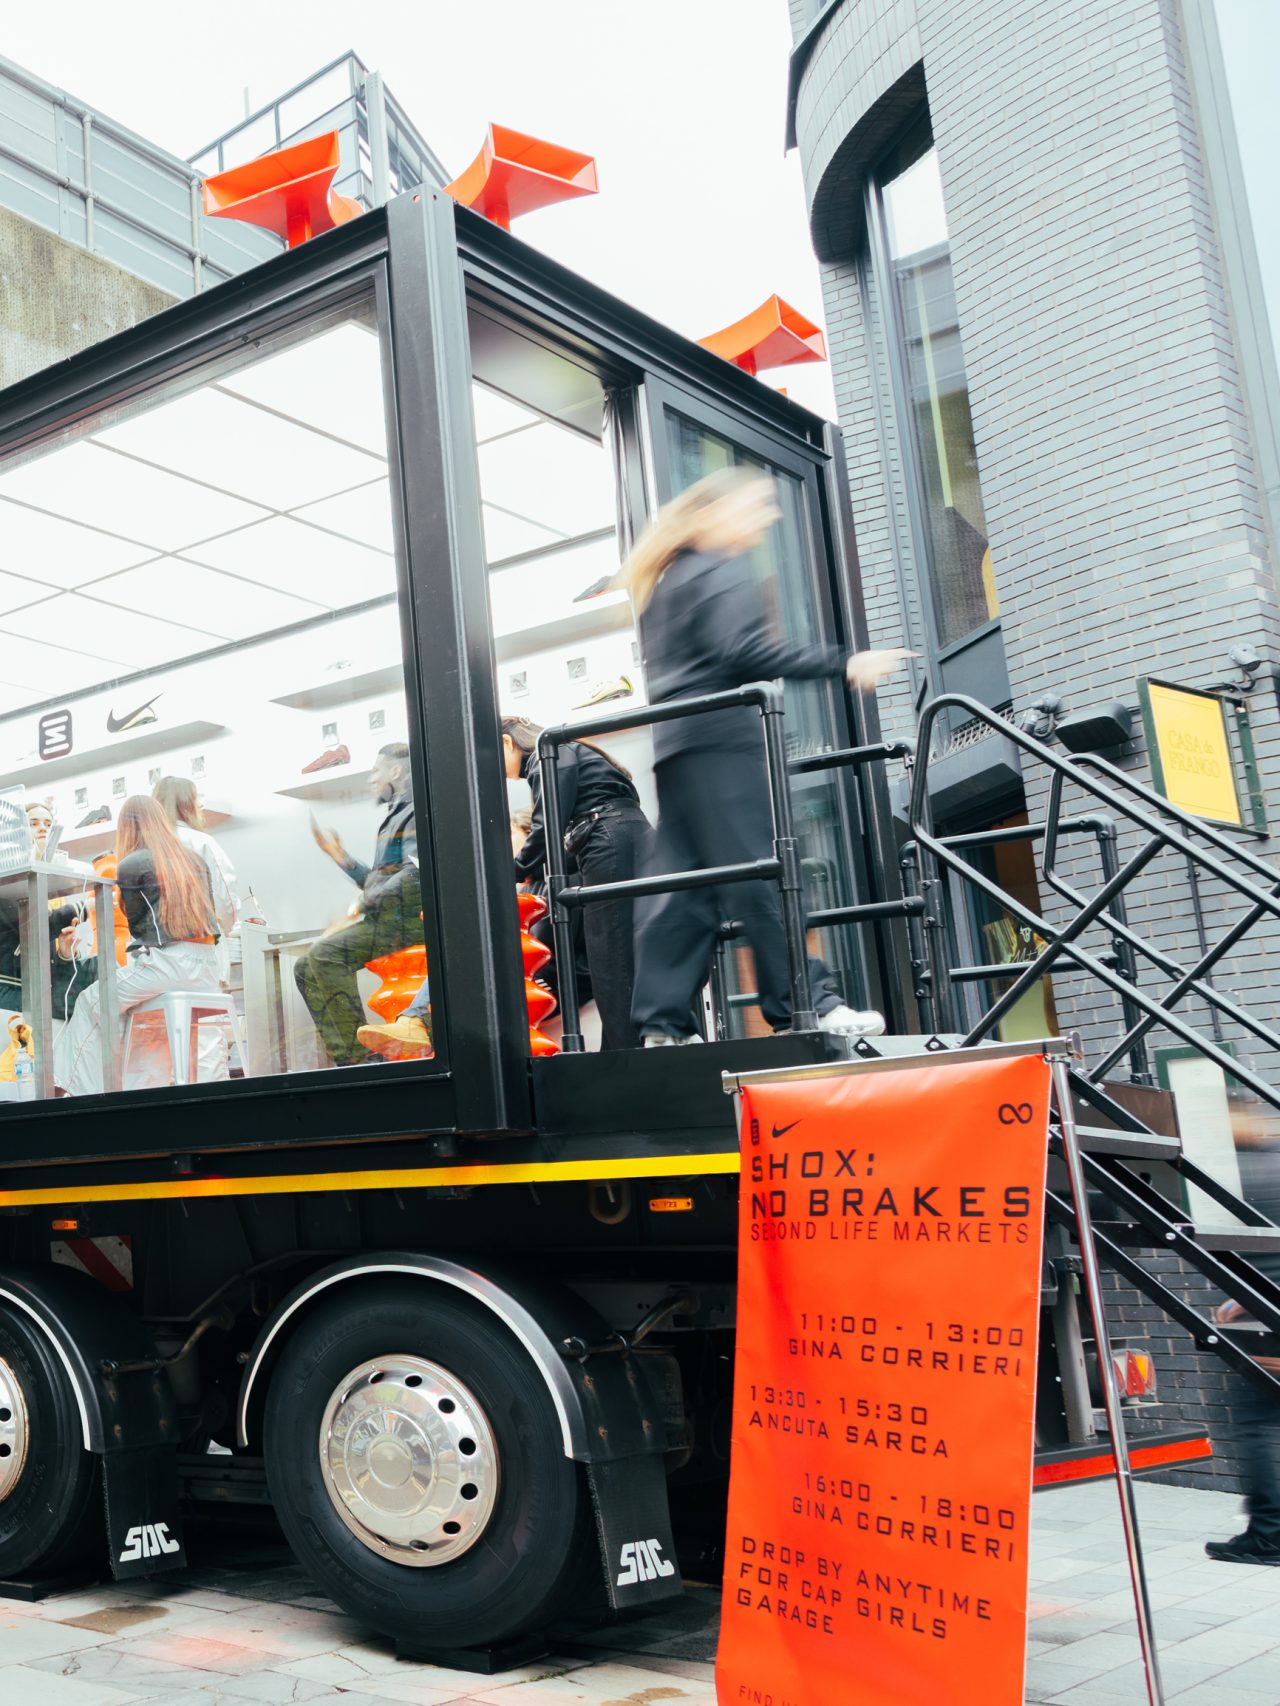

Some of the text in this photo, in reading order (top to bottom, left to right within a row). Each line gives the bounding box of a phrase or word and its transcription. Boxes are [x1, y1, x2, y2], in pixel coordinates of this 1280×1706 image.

[1168, 750, 1220, 778] FRANGO
[752, 1149, 876, 1182] SHOX:
[752, 1186, 1030, 1219] NO BRAKES
[751, 1221, 1028, 1244] SECOND LIFE MARKETS
[800, 1313, 876, 1335] 11:00
[926, 1322, 1024, 1346] 13:00
[789, 1338, 1022, 1377] GINA CORRIERI
[750, 1386, 806, 1408] 13:30
[840, 1397, 928, 1426] 15:30
[749, 1411, 948, 1458] ANCUTA SARCA
[804, 1472, 871, 1502] 16:00
[920, 1495, 1016, 1530] 18:00
[119, 1522, 180, 1562] SDC
[792, 1497, 1014, 1562] GINA CORRIERI
[616, 1538, 675, 1587] SDC
[742, 1536, 992, 1621] DROP BY ANYTIME
[737, 1588, 834, 1634] GARAGE
[740, 1562, 948, 1640] FOR CAP GIRLS
[739, 1685, 773, 1706] FIND
